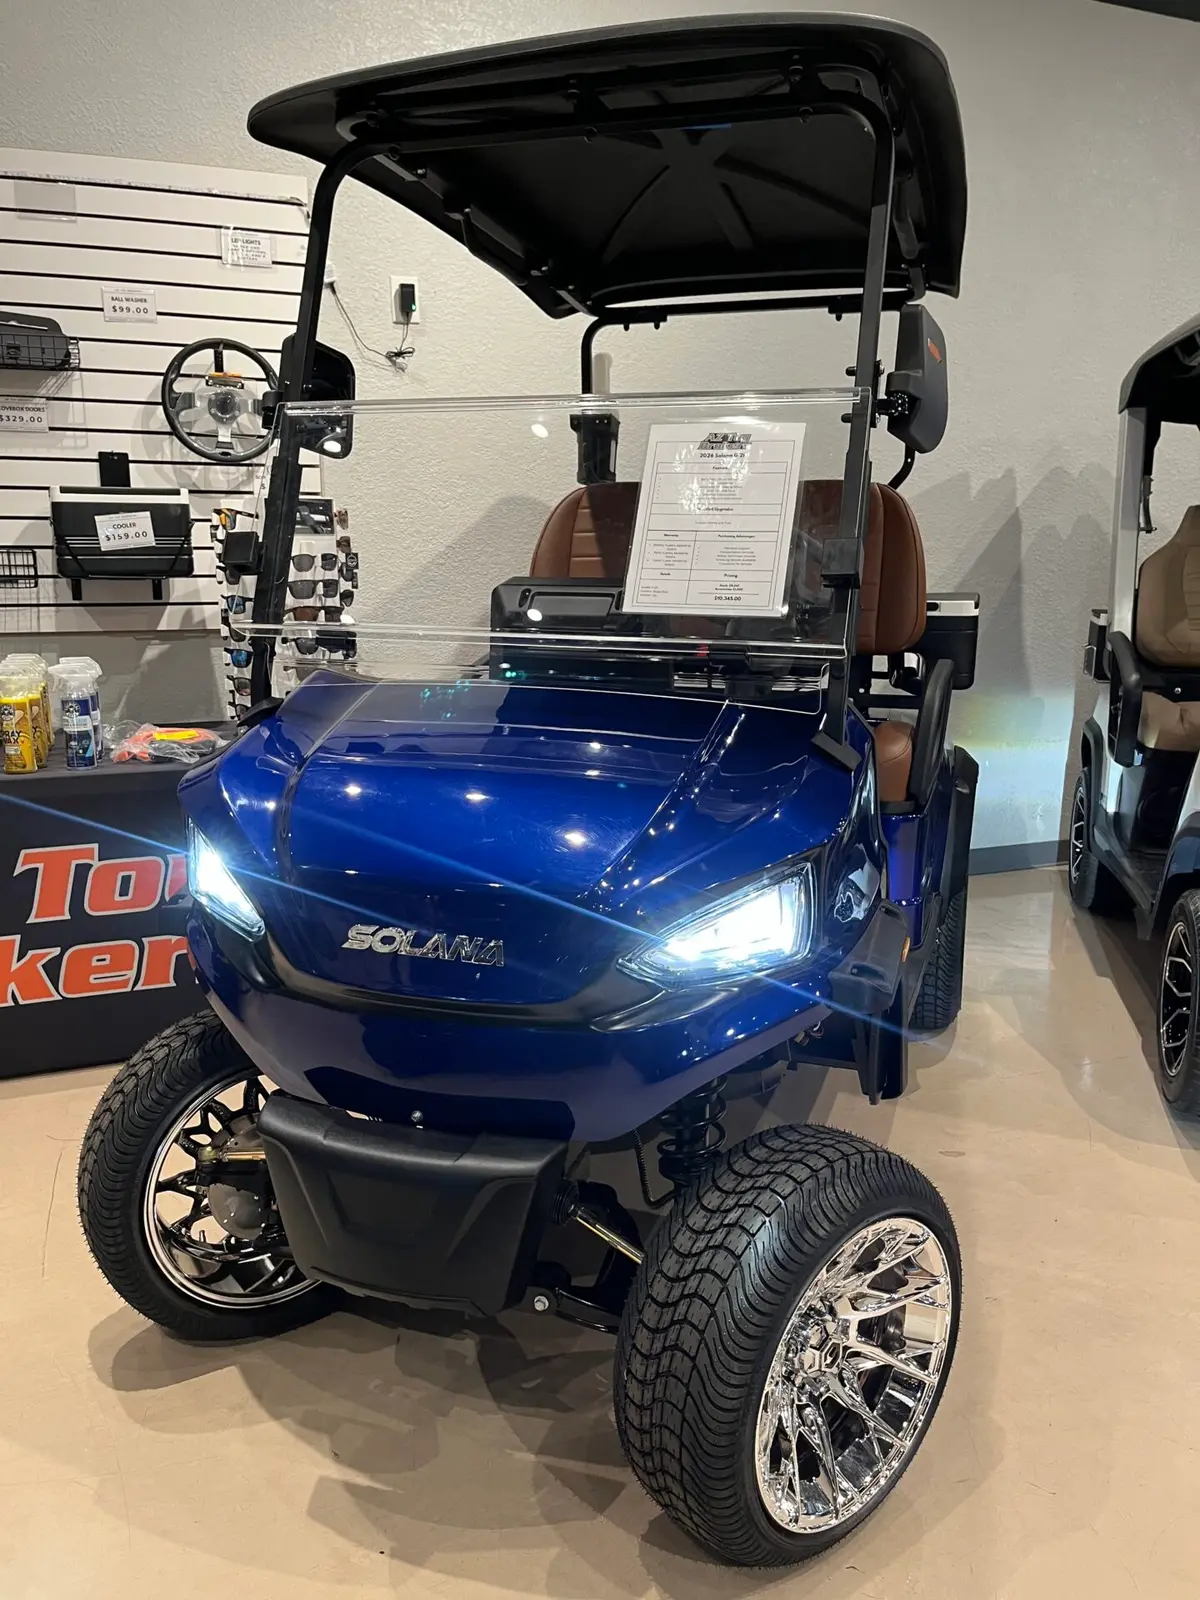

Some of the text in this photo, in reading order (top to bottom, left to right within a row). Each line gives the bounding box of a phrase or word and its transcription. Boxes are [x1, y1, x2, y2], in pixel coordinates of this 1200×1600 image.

[112, 304, 149, 314] $99.00
[0, 415, 43, 424] $329.00
[112, 522, 137, 530] COOLER
[105, 531, 148, 542] $159.00
[341, 924, 505, 969] SOLANA
